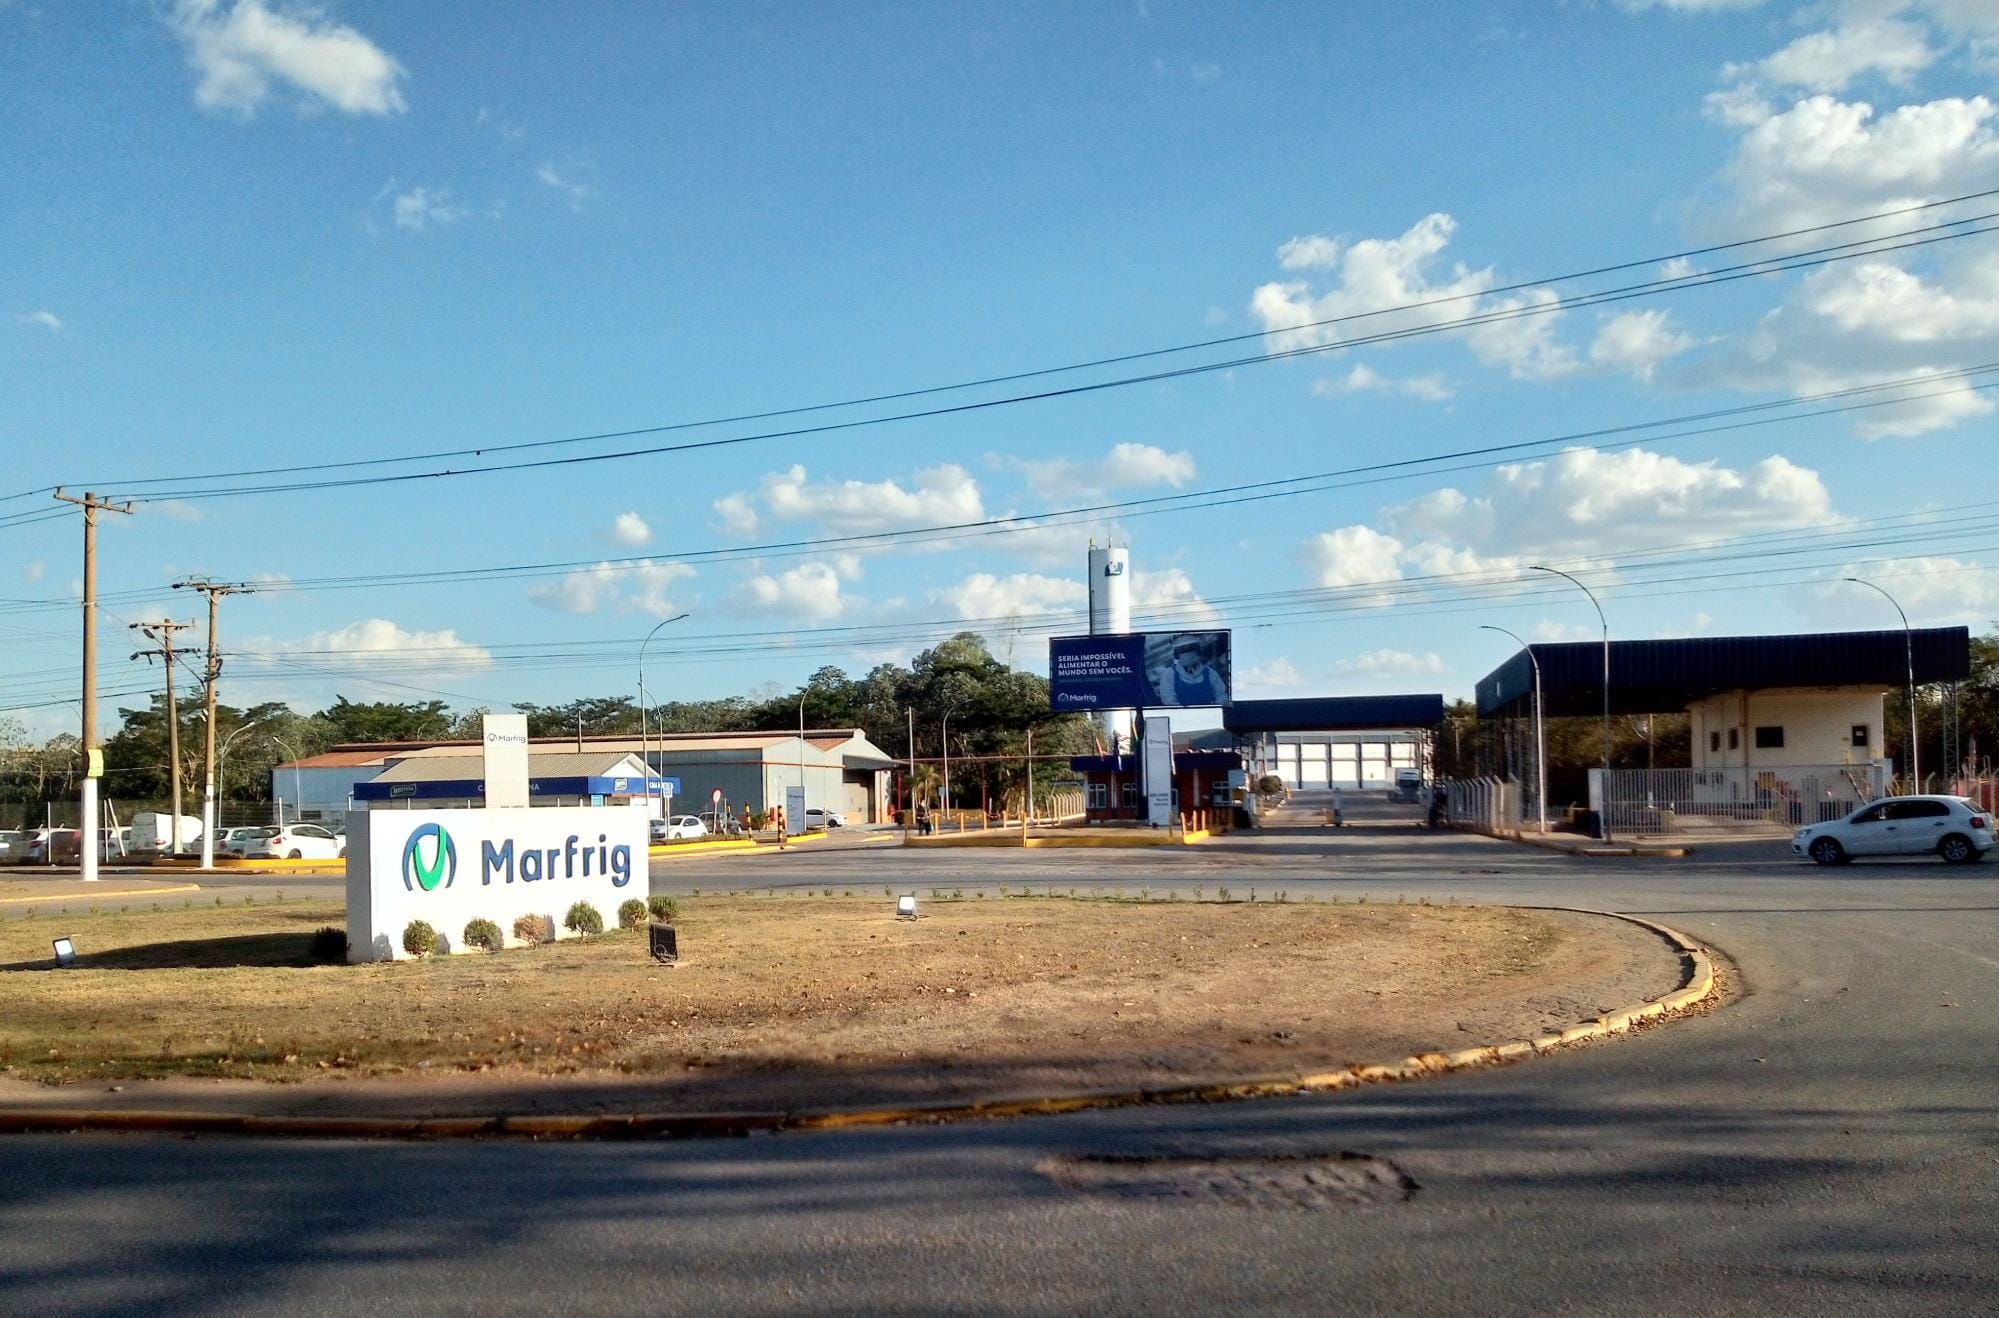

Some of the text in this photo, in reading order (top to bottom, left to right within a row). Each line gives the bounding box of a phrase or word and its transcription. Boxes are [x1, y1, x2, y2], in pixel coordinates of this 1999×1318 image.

[1080, 652, 1126, 661] IMPOSSÍVEL
[1058, 661, 1100, 669] ALIMENTAR
[1058, 668, 1087, 676] MUNDO
[1088, 667, 1104, 675] SEM
[482, 834, 631, 888] Marfrig
